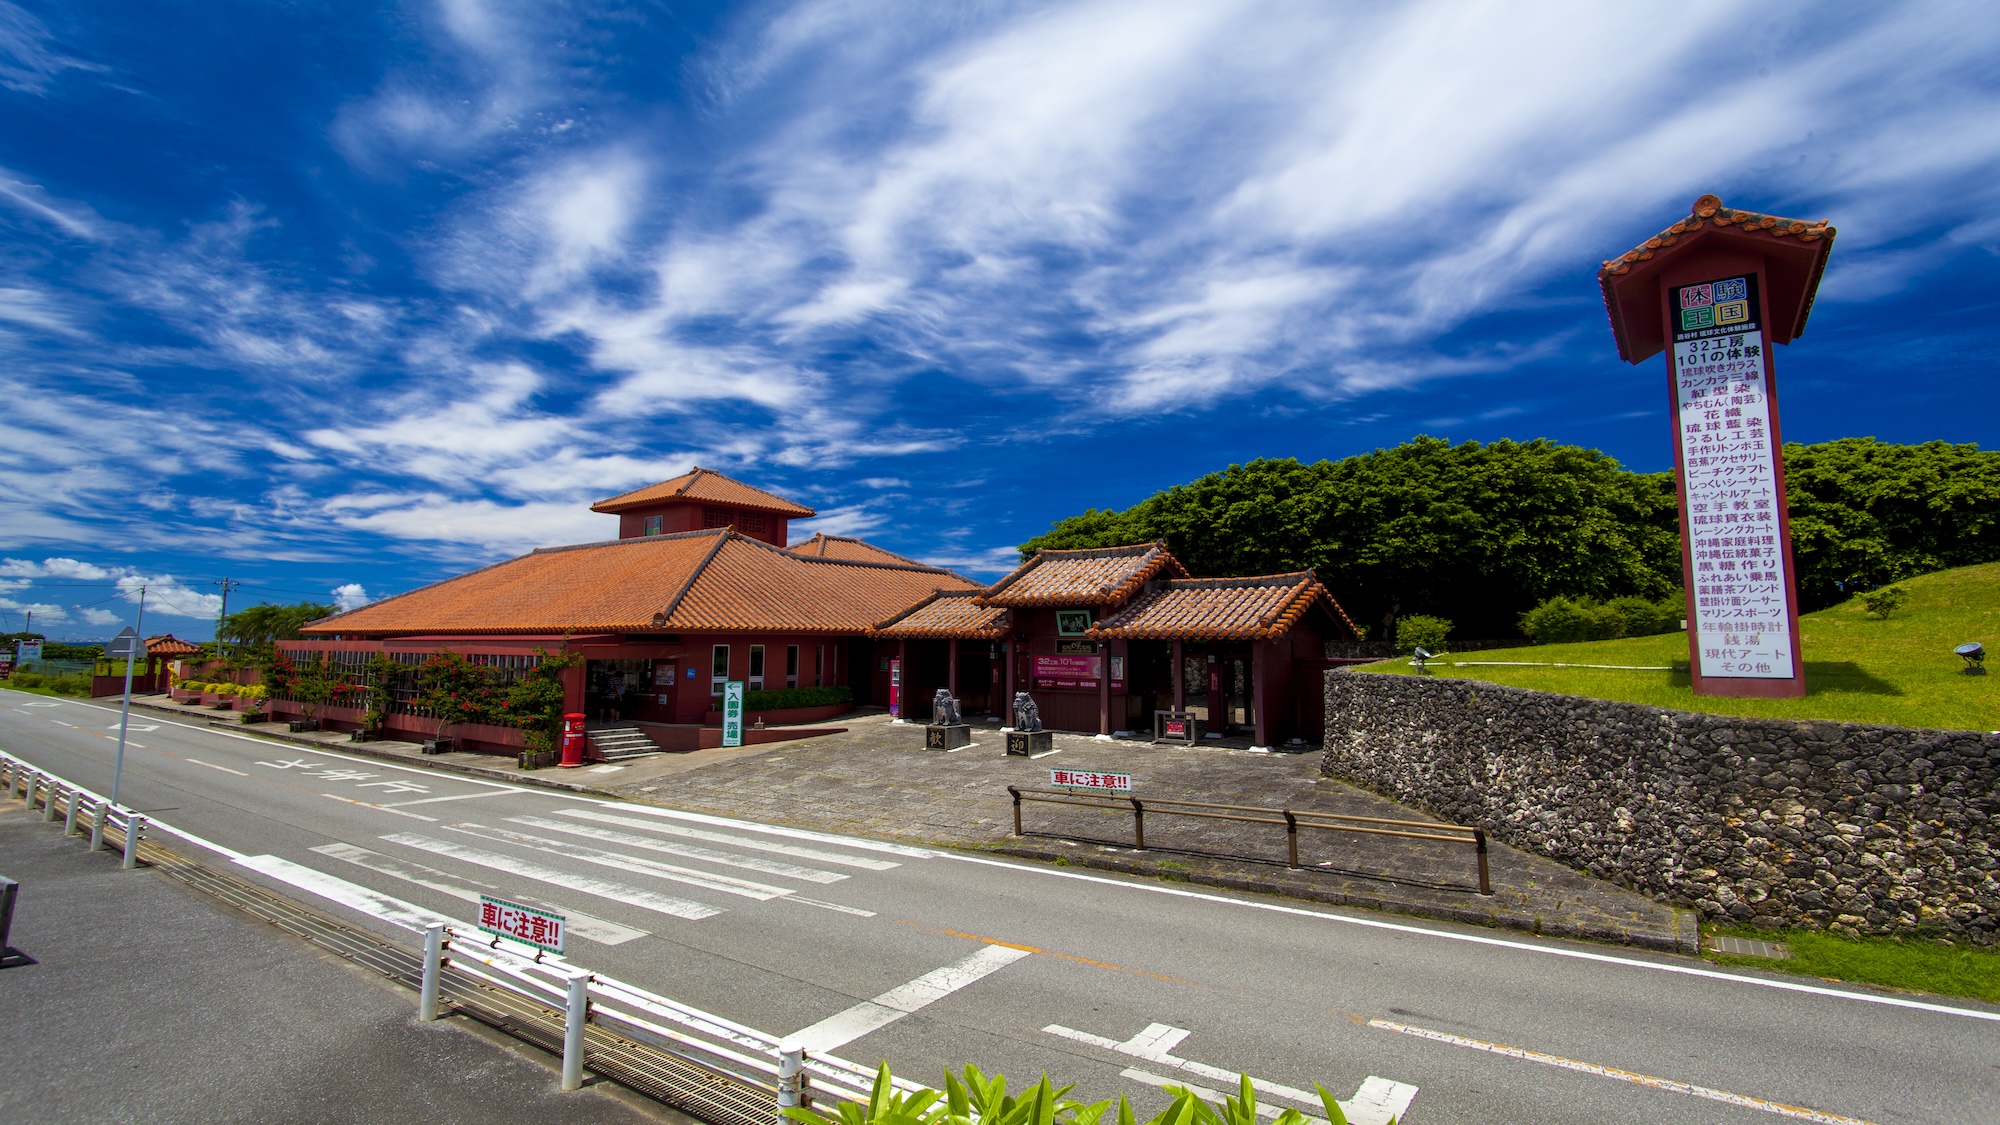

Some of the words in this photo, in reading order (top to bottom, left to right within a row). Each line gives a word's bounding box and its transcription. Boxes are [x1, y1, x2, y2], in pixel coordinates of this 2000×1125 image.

[1684, 281, 1744, 306] 体験
[1686, 303, 1744, 327] 王国
[1689, 334, 1744, 353] 32工房
[1678, 345, 1760, 366] 101の体験
[1681, 359, 1757, 377] 琉球吹きガラス
[1681, 371, 1759, 388] カンカラ三線
[1691, 383, 1751, 399] 紅型染
[1703, 407, 1742, 420] 花織
[1686, 417, 1763, 433] 琉球藍染
[1686, 428, 1764, 443] うるし工芸
[1687, 440, 1766, 456] 手作りトンボ玉
[1687, 453, 1767, 468] 芭蕉アクセサリー
[1688, 464, 1768, 478] ビーチクラフト
[1689, 476, 1769, 490] しっくいシーサー
[1690, 487, 1771, 501] キャンドルアート
[1693, 499, 1770, 513] 空手教室
[1693, 523, 1773, 536] レーシングカート
[1694, 535, 1775, 548] 沖縄家庭料理
[1696, 547, 1776, 560] 沖縄伝統菓子
[1698, 559, 1775, 571] 黒糖作り
[1698, 571, 1777, 583] ふれあい乗馬
[1698, 584, 1780, 595] 薬膳茶ブレンド
[1699, 596, 1780, 607] 壁掛け面シーサー
[1700, 608, 1781, 618] マリンスポーツ
[1702, 621, 1783, 632] 年輪掛時計
[1723, 634, 1760, 646] 銭湯
[1705, 649, 1786, 659] 現代アート
[1720, 662, 1772, 674] その他
[727, 692, 739, 718] 入園券
[1010, 738, 1026, 754] 迎
[1053, 771, 1127, 789] 車に注意!!
[481, 902, 560, 946] 車に注意!!
